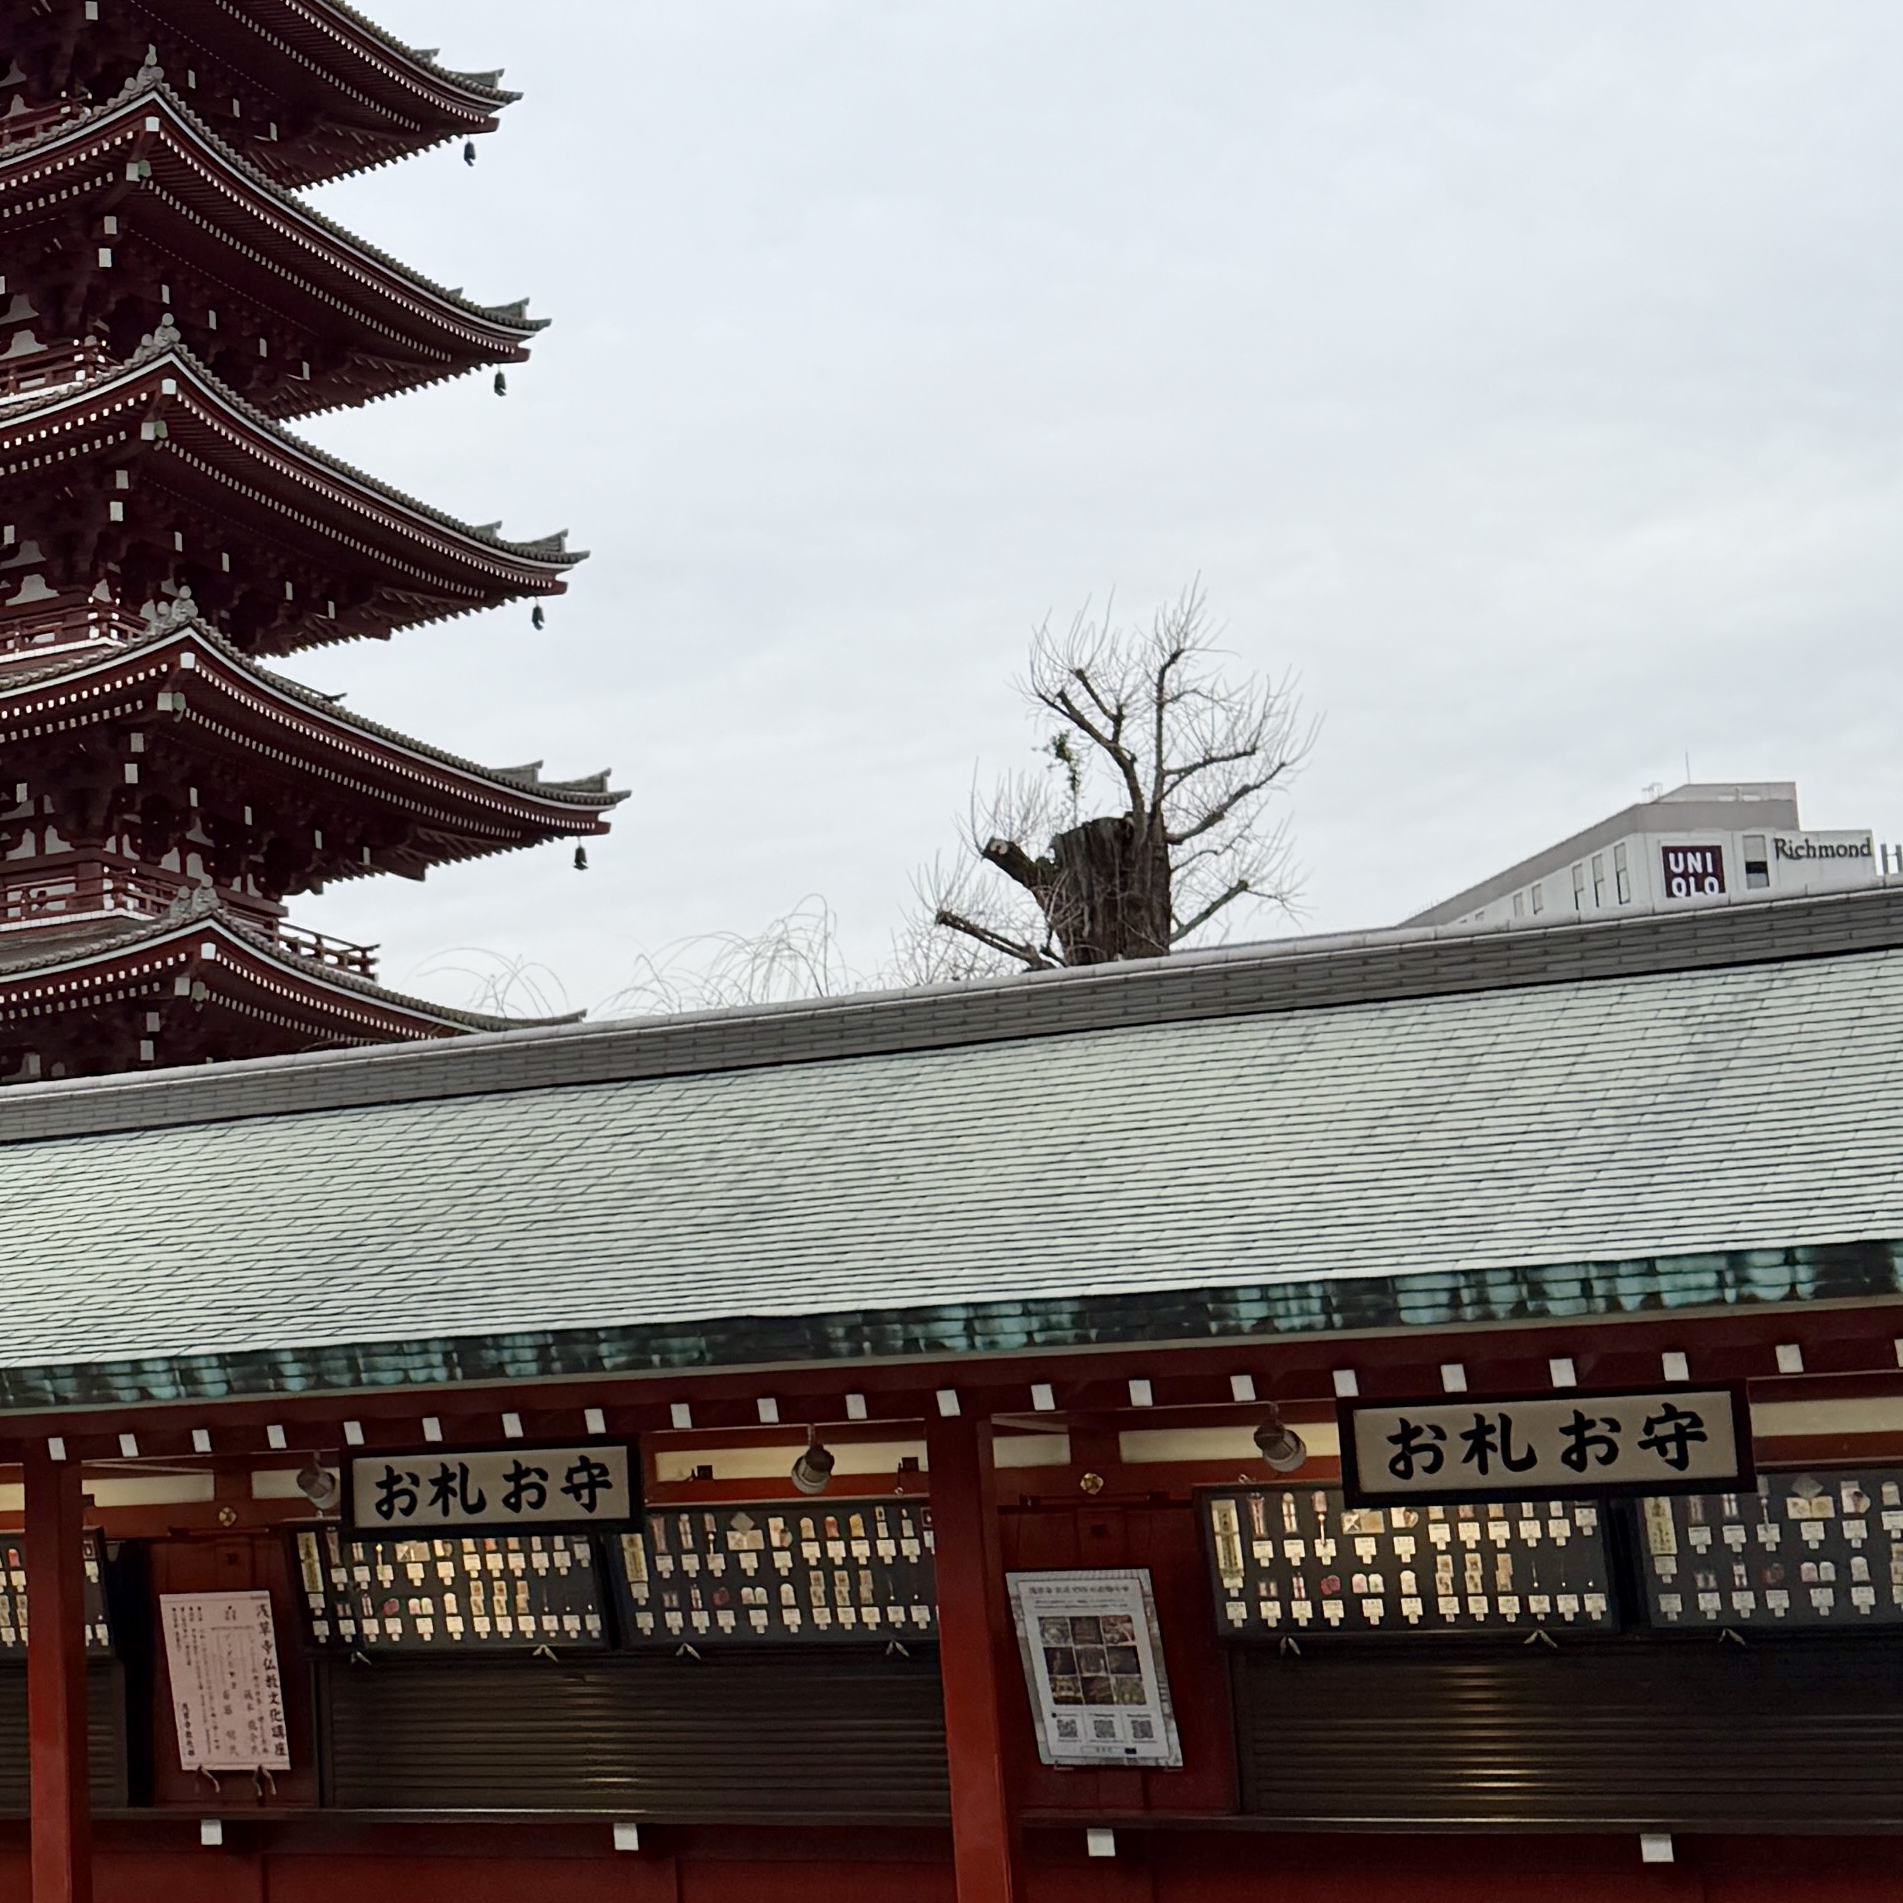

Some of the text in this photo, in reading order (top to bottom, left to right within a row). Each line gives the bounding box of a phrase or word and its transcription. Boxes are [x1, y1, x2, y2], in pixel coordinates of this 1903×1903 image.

[1774, 837, 1872, 860] Richmond
[1669, 852, 1713, 873] UNI
[1672, 876, 1720, 897] QLO
[1387, 1402, 1709, 1480] お札お守
[375, 1455, 613, 1520] お札お守
